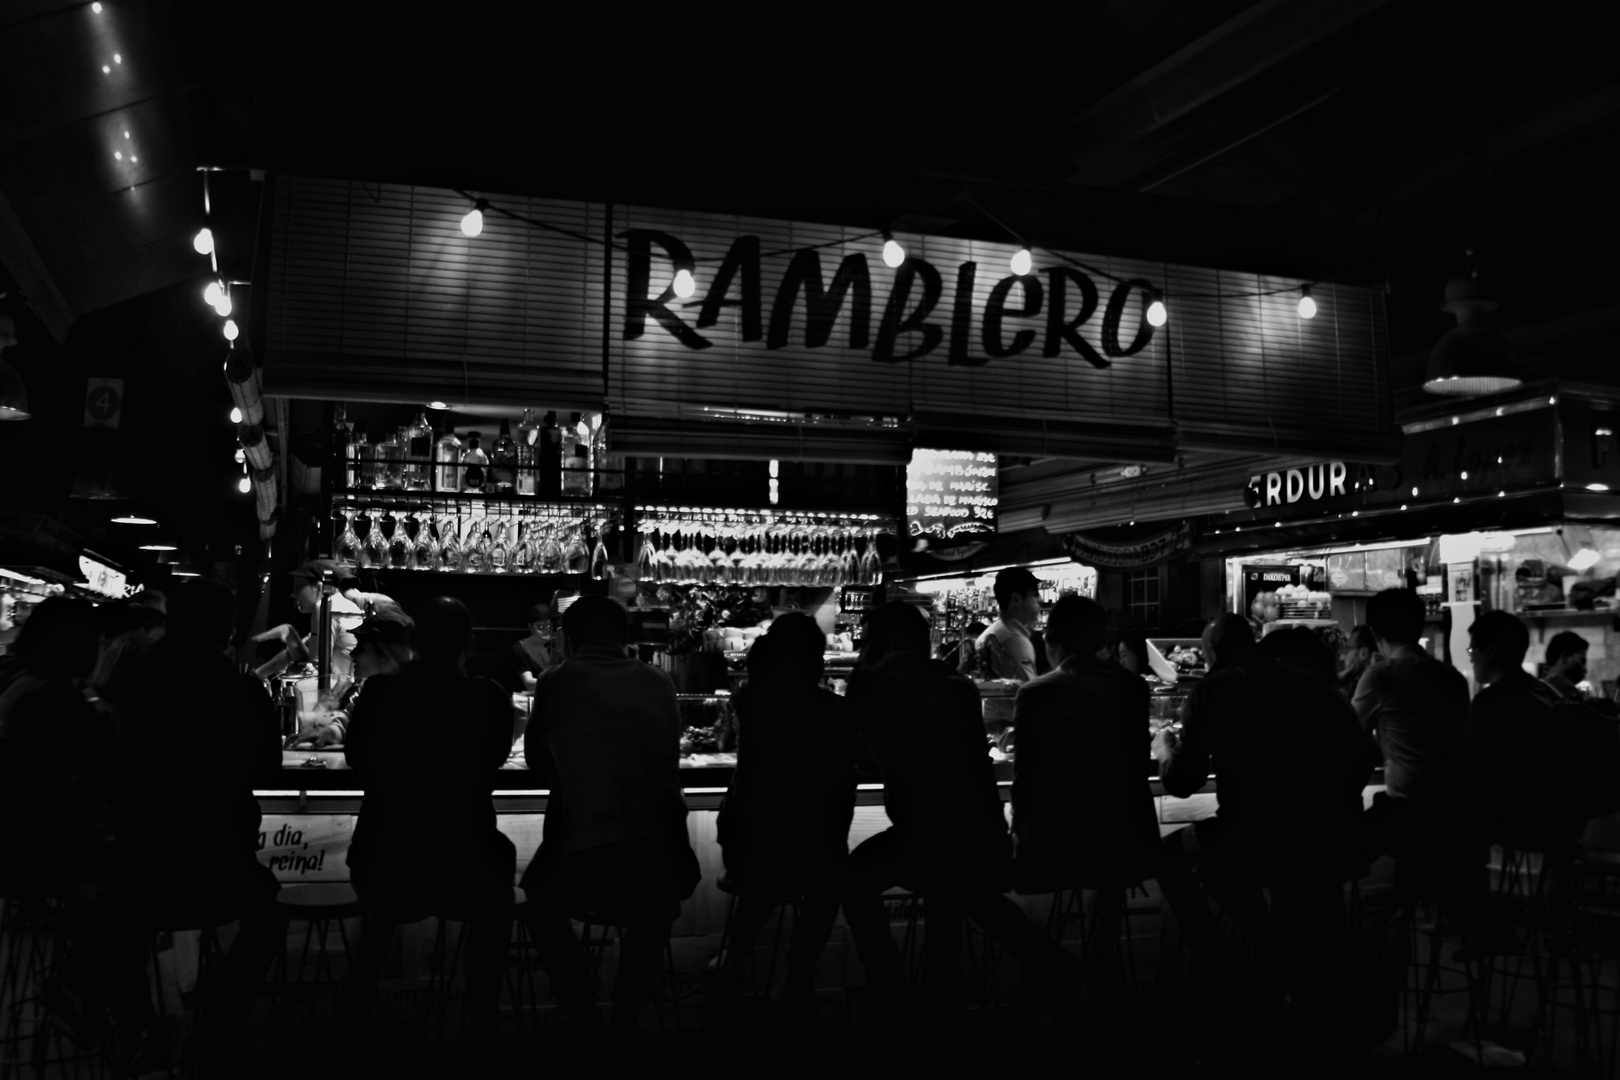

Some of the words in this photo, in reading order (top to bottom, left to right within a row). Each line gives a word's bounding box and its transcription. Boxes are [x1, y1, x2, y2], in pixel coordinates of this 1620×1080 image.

[96, 392, 111, 415] 4
[924, 506, 970, 518] SEAFOOD
[1262, 573, 1291, 582] DIADEMA
[273, 823, 309, 850] dia,
[269, 849, 325, 875] reina!
